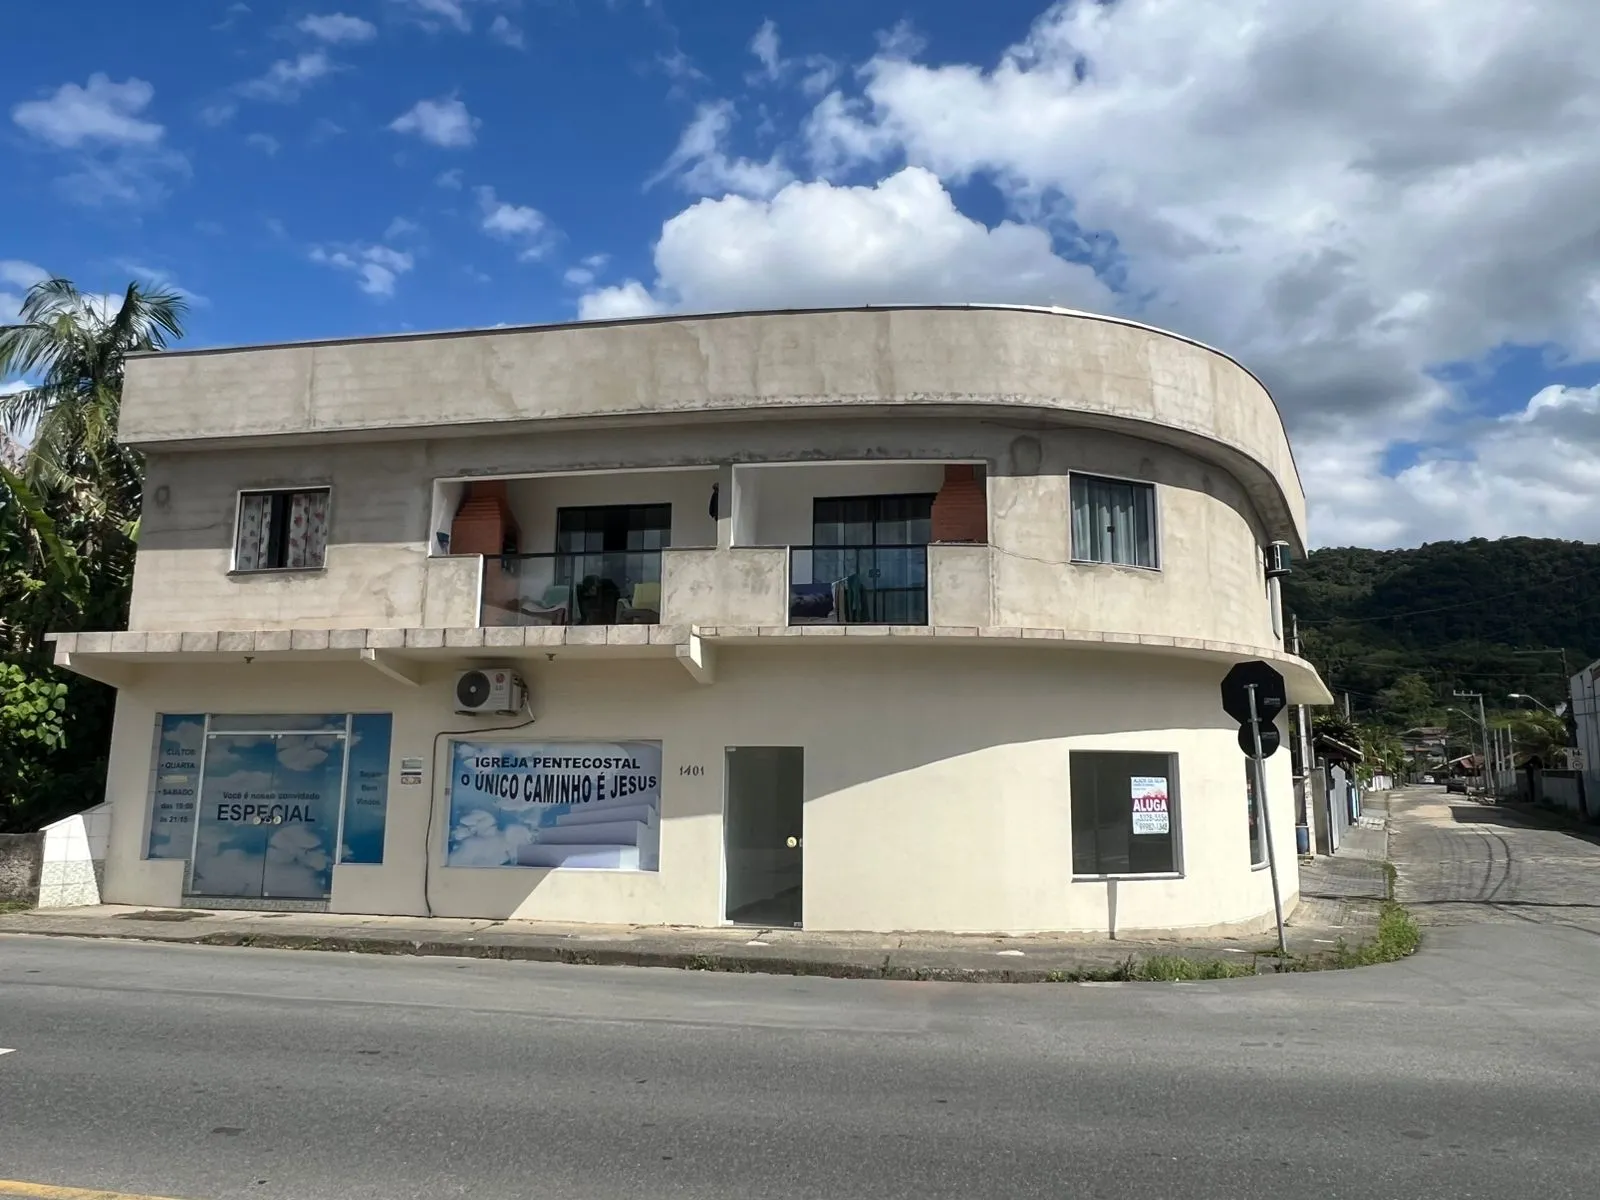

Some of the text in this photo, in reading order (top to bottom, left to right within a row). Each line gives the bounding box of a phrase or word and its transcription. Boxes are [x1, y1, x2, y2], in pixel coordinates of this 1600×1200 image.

[165, 761, 196, 769] QUARTA
[475, 757, 641, 770] IGREJA PENTECOSTAL
[679, 765, 705, 777] 1401
[461, 770, 657, 805] O ÚNICO CAMINHO É JESUS
[223, 791, 242, 800] Você
[1133, 798, 1168, 812] ALUGA
[217, 803, 316, 822] ESPECIAL
